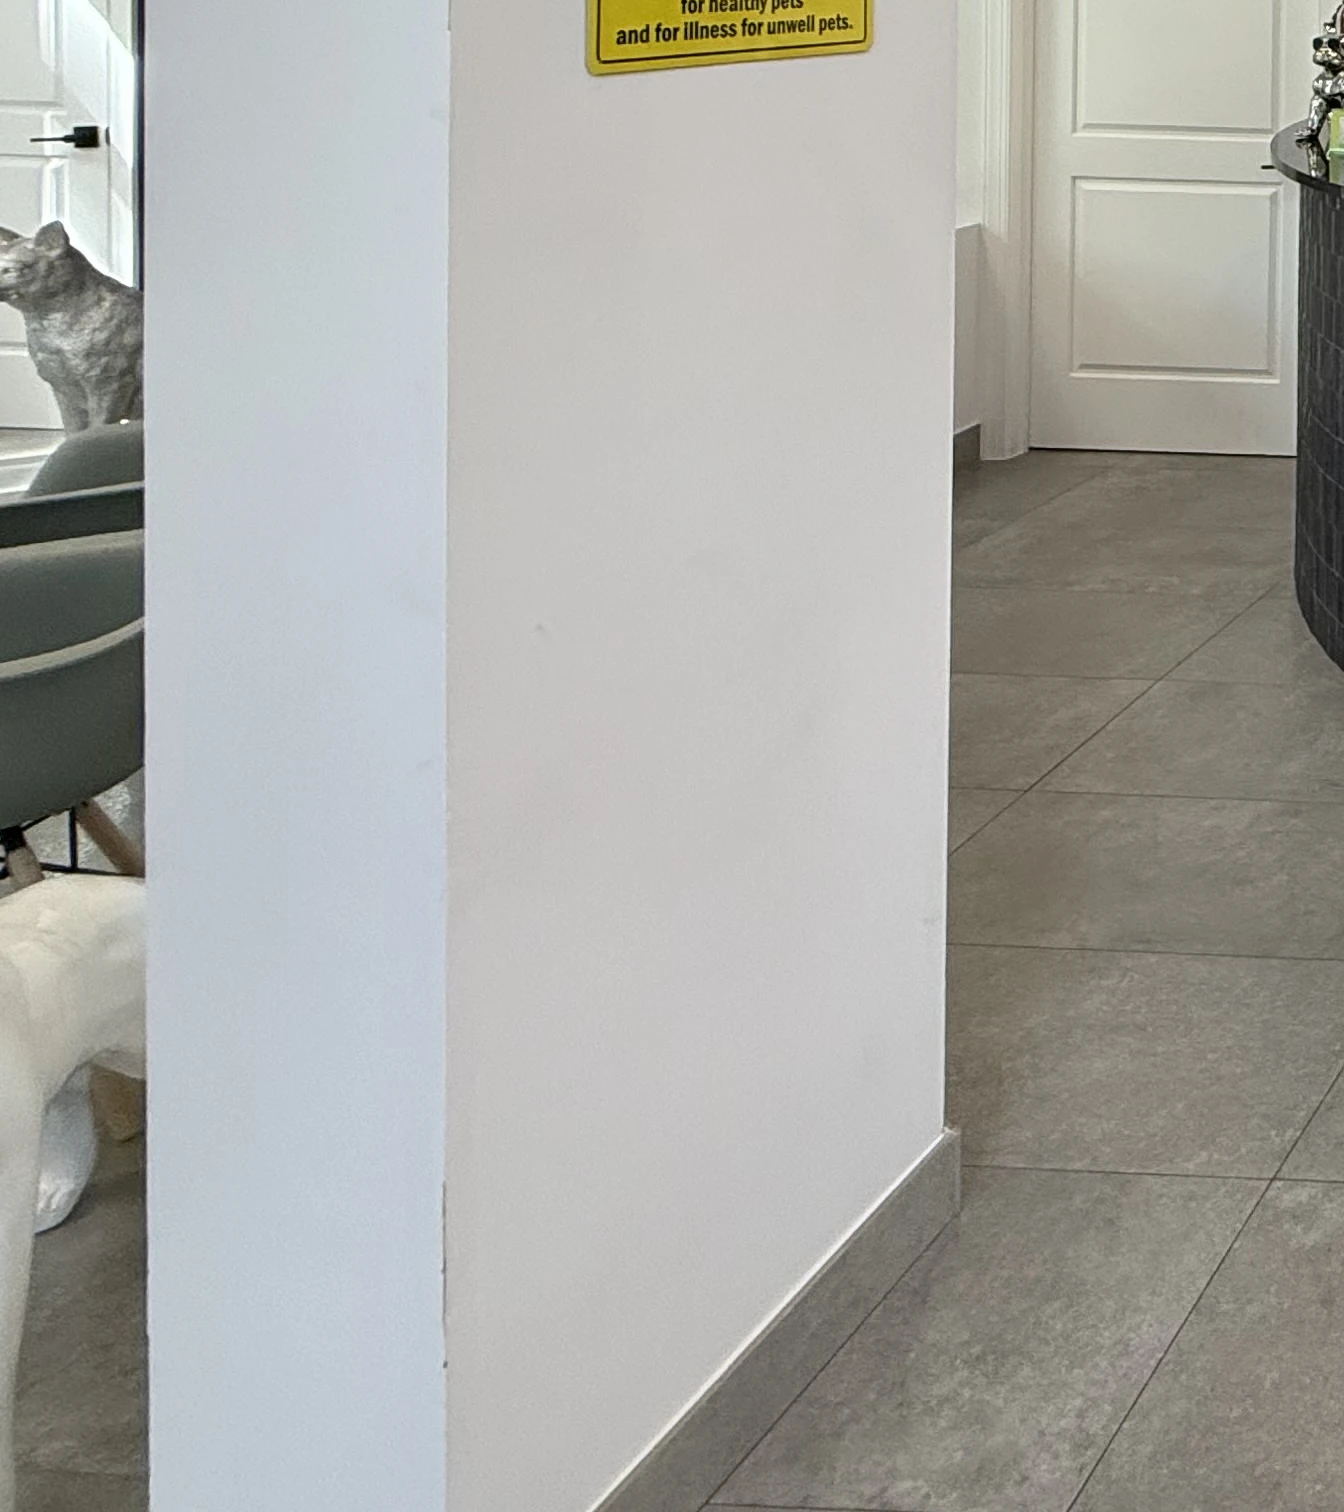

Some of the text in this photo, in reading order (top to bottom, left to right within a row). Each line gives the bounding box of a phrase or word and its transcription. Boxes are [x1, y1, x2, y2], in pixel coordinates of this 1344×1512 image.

[616, 13, 854, 45] and for illness for unwell pets.
